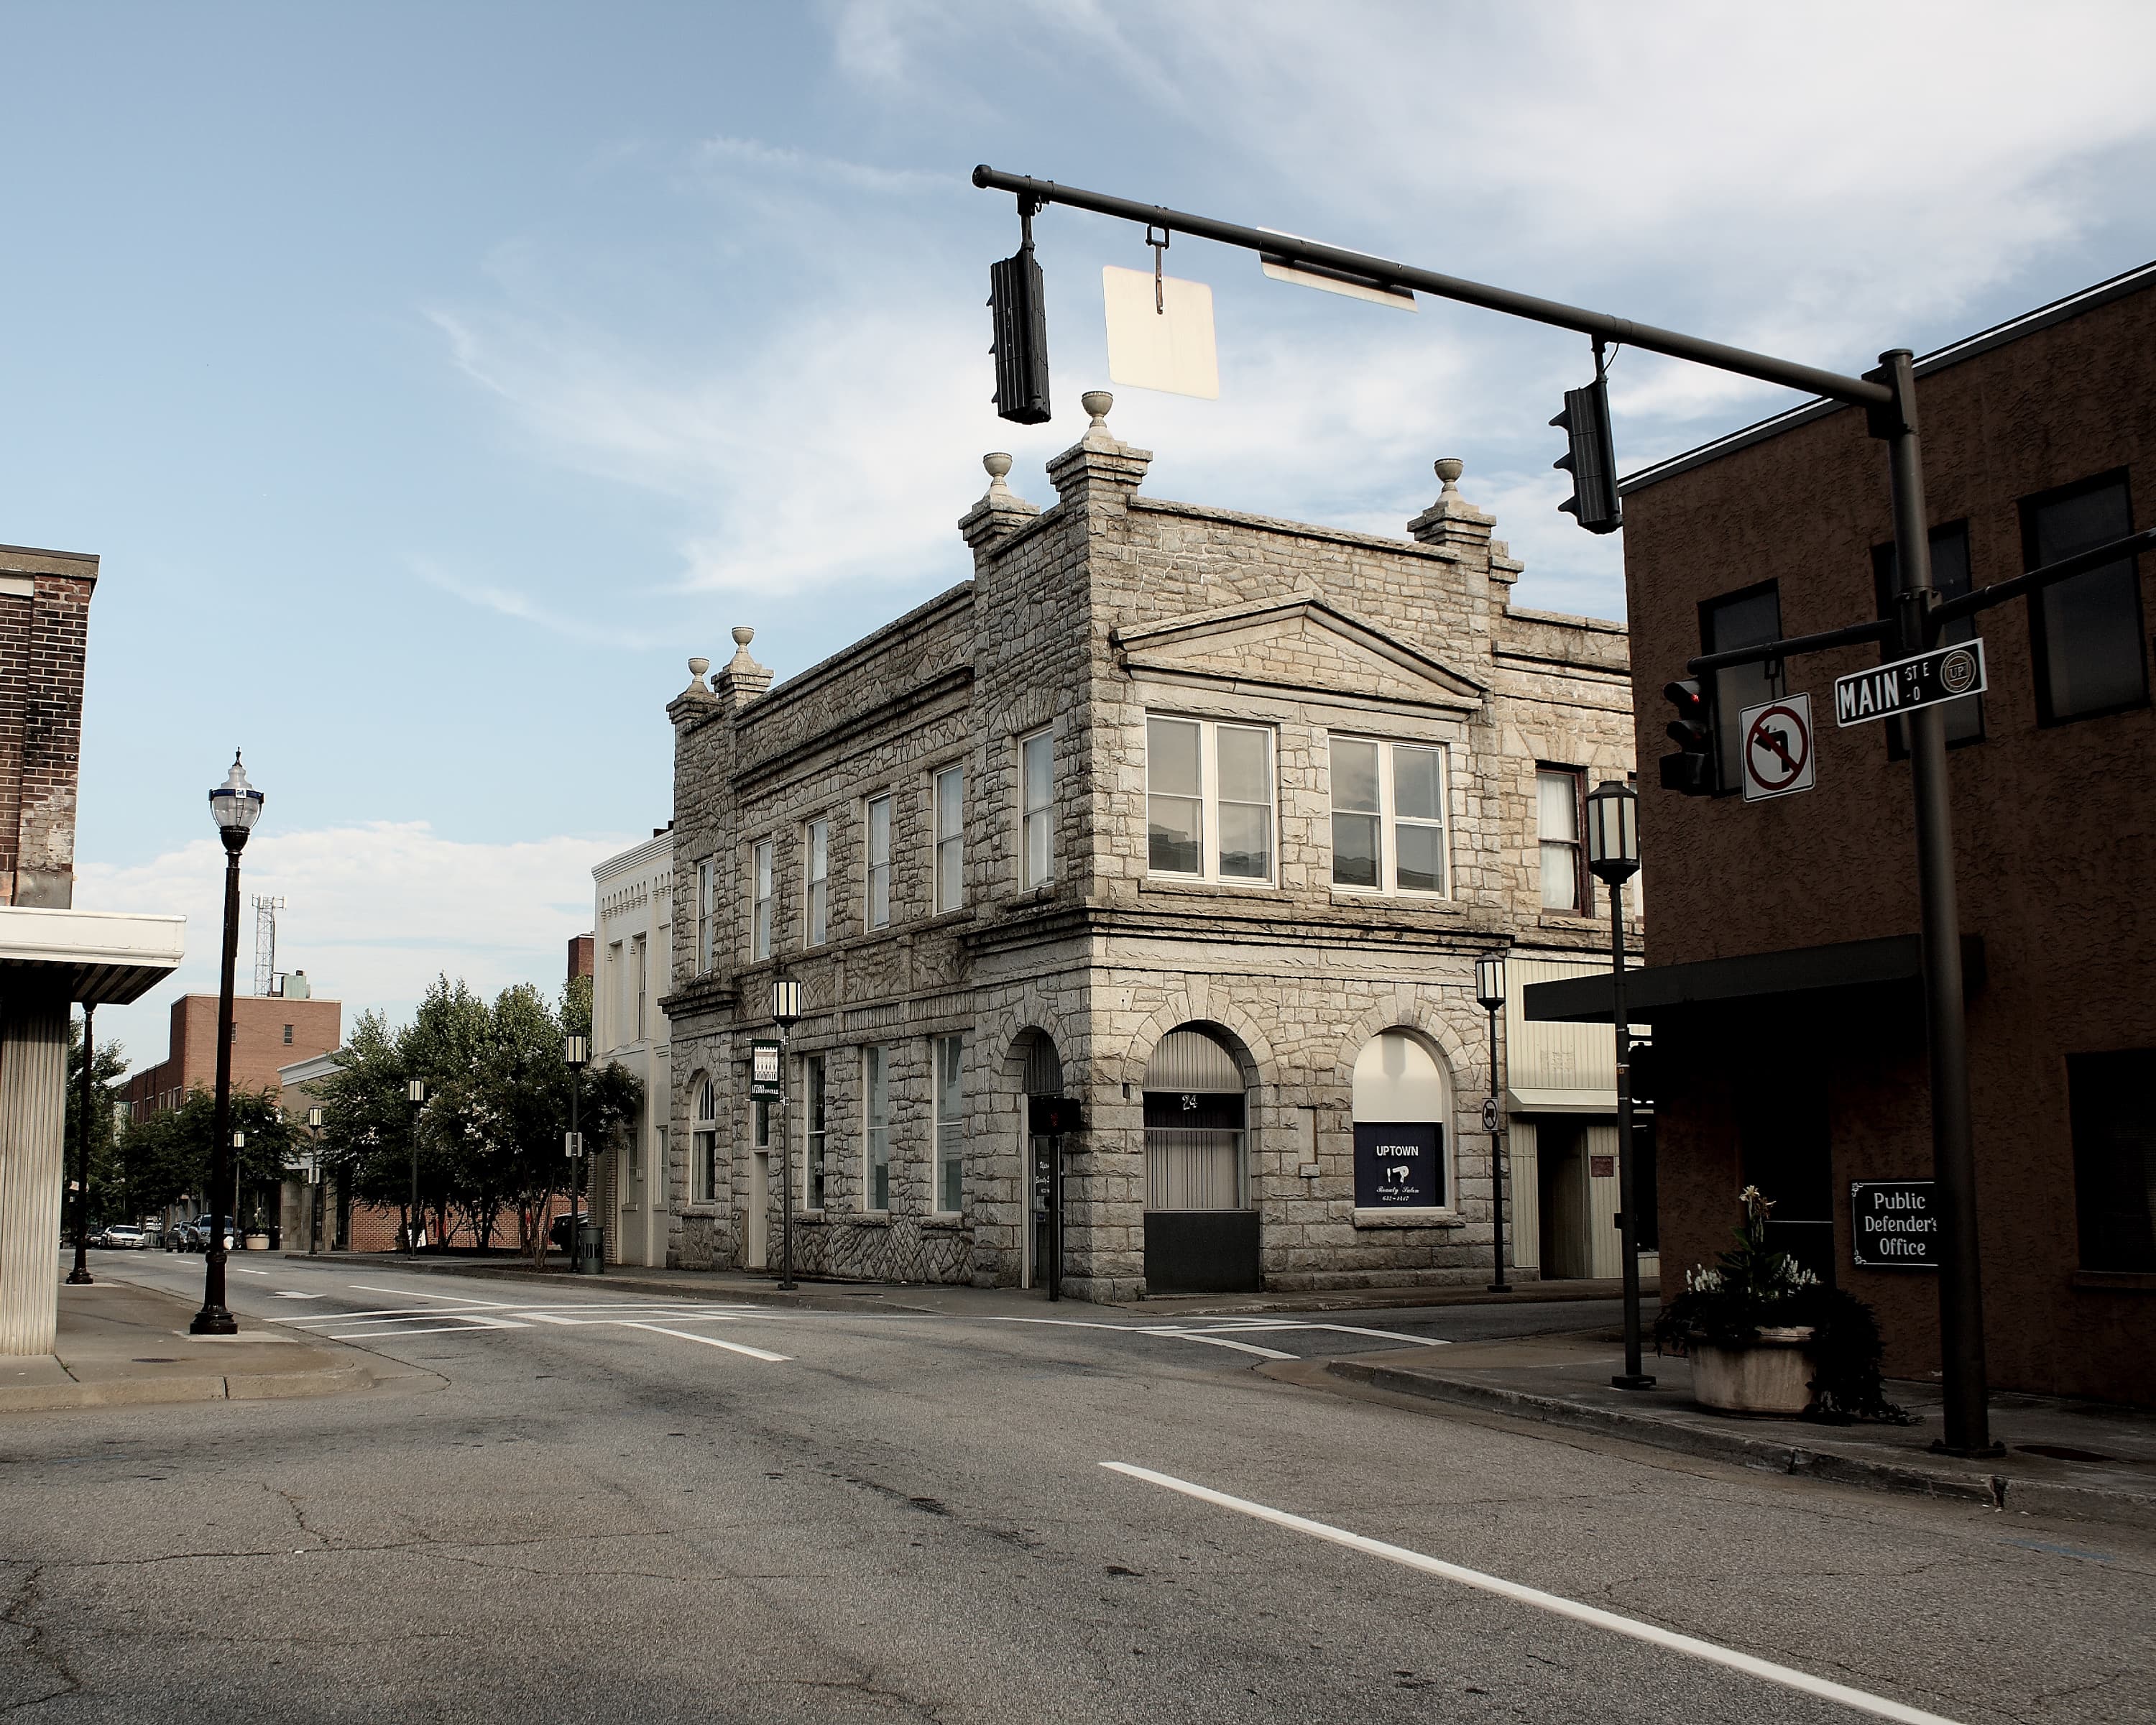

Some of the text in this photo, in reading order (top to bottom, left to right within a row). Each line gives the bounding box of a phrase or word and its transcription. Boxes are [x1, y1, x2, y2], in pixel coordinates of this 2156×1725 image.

[1840, 662, 1930, 719] MAIN ST E
[1182, 1095, 1198, 1110] 24
[1376, 1146, 1419, 1156] UPTOWN
[1874, 1192, 1926, 1210] Public
[1864, 1215, 1938, 1233] Defender's
[1879, 1237, 1926, 1256] Office
